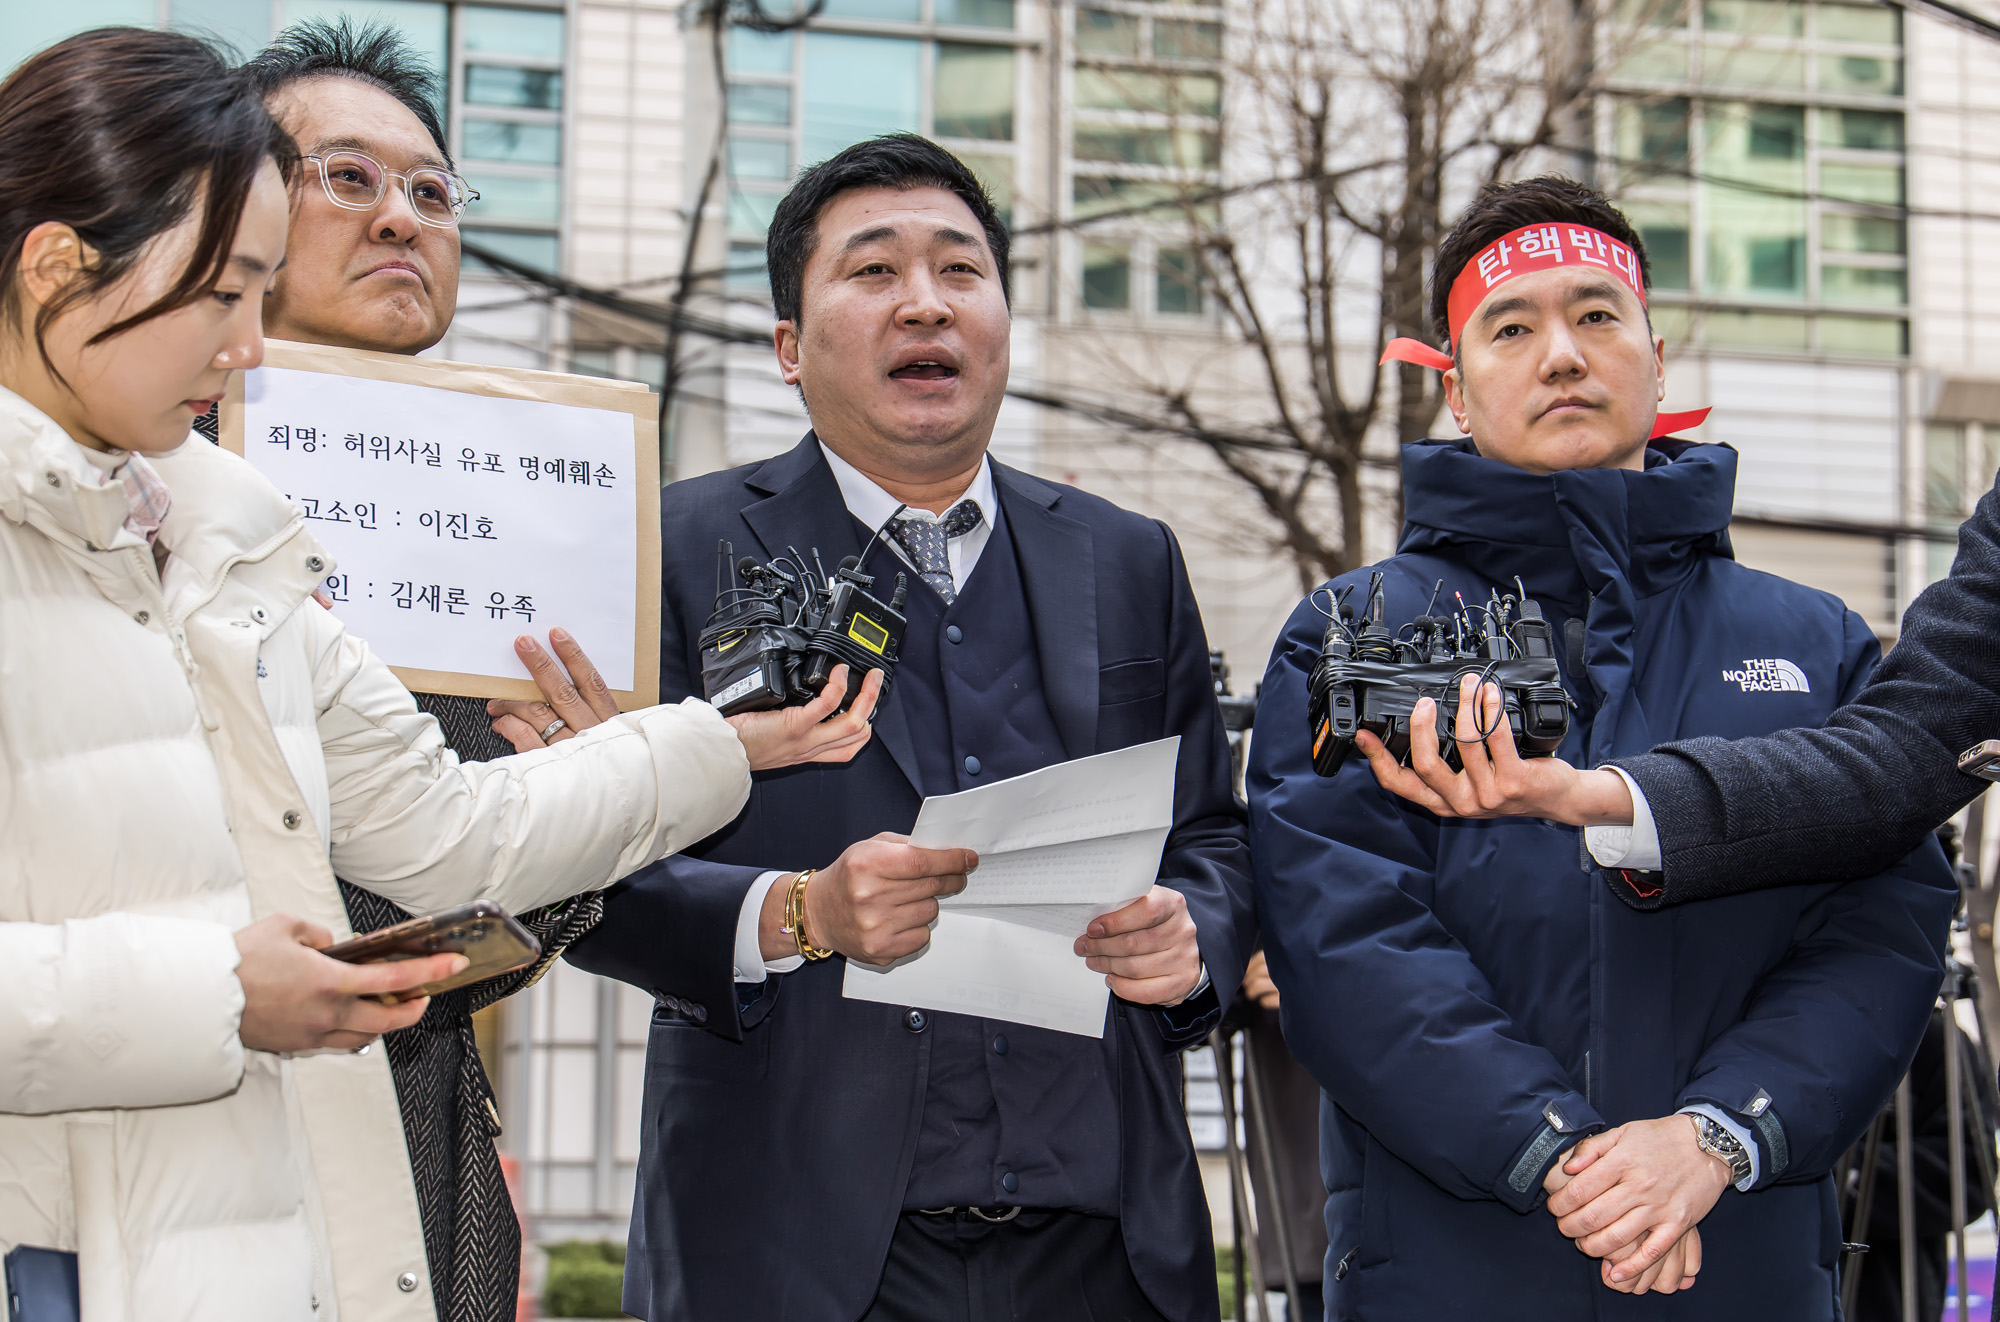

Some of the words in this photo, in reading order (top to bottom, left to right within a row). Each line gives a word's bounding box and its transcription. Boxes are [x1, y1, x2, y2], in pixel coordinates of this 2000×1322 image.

[267, 424, 327, 453] 죄명:
[343, 432, 442, 468] 허위사실
[456, 447, 505, 473] 유포
[519, 456, 616, 489] 명예훼손
[285, 494, 378, 530] 고소인
[419, 509, 498, 540] 이진호
[390, 581, 470, 616] 김새론
[484, 591, 537, 623] 유족
[1722, 669, 1778, 682] NORTH
[1743, 658, 1776, 670] THE
[1740, 680, 1782, 692] FACE
